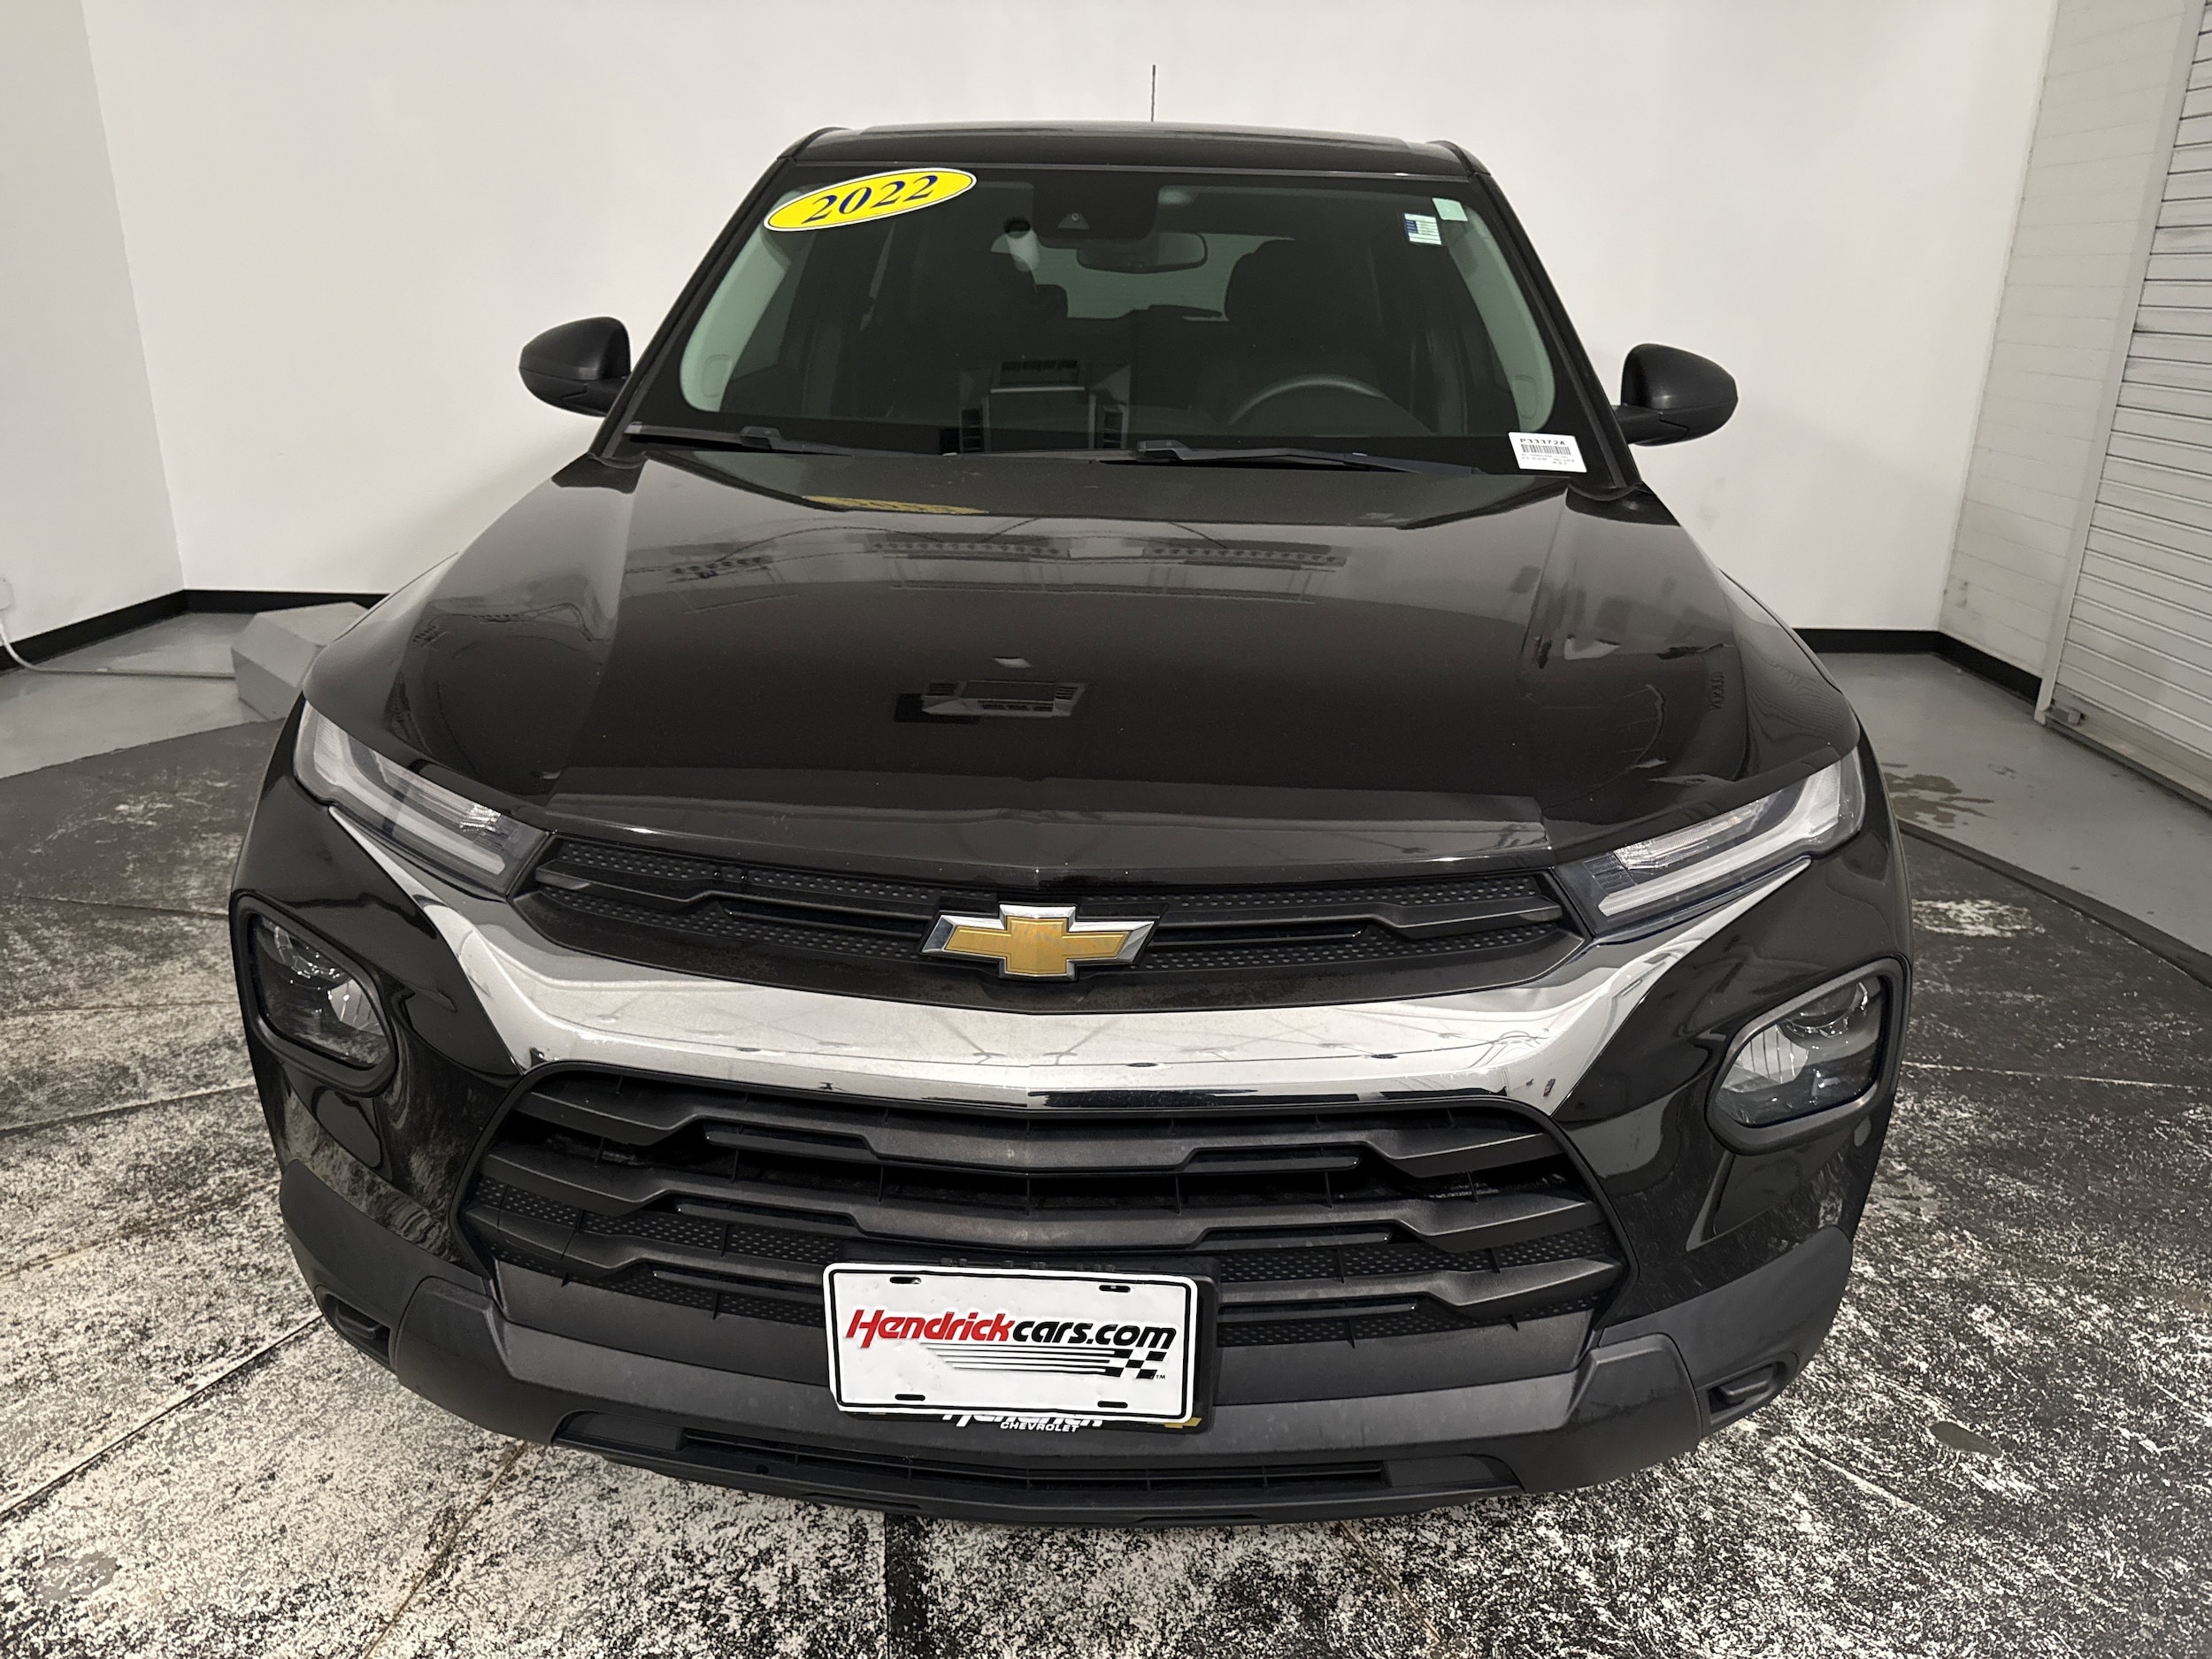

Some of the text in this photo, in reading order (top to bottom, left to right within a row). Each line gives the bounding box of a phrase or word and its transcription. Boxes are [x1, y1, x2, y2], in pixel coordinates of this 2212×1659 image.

[801, 175, 938, 225] 2022
[845, 1310, 1177, 1350] Hendrickcars.com
[1000, 1421, 1079, 1432] CHEVROLET
